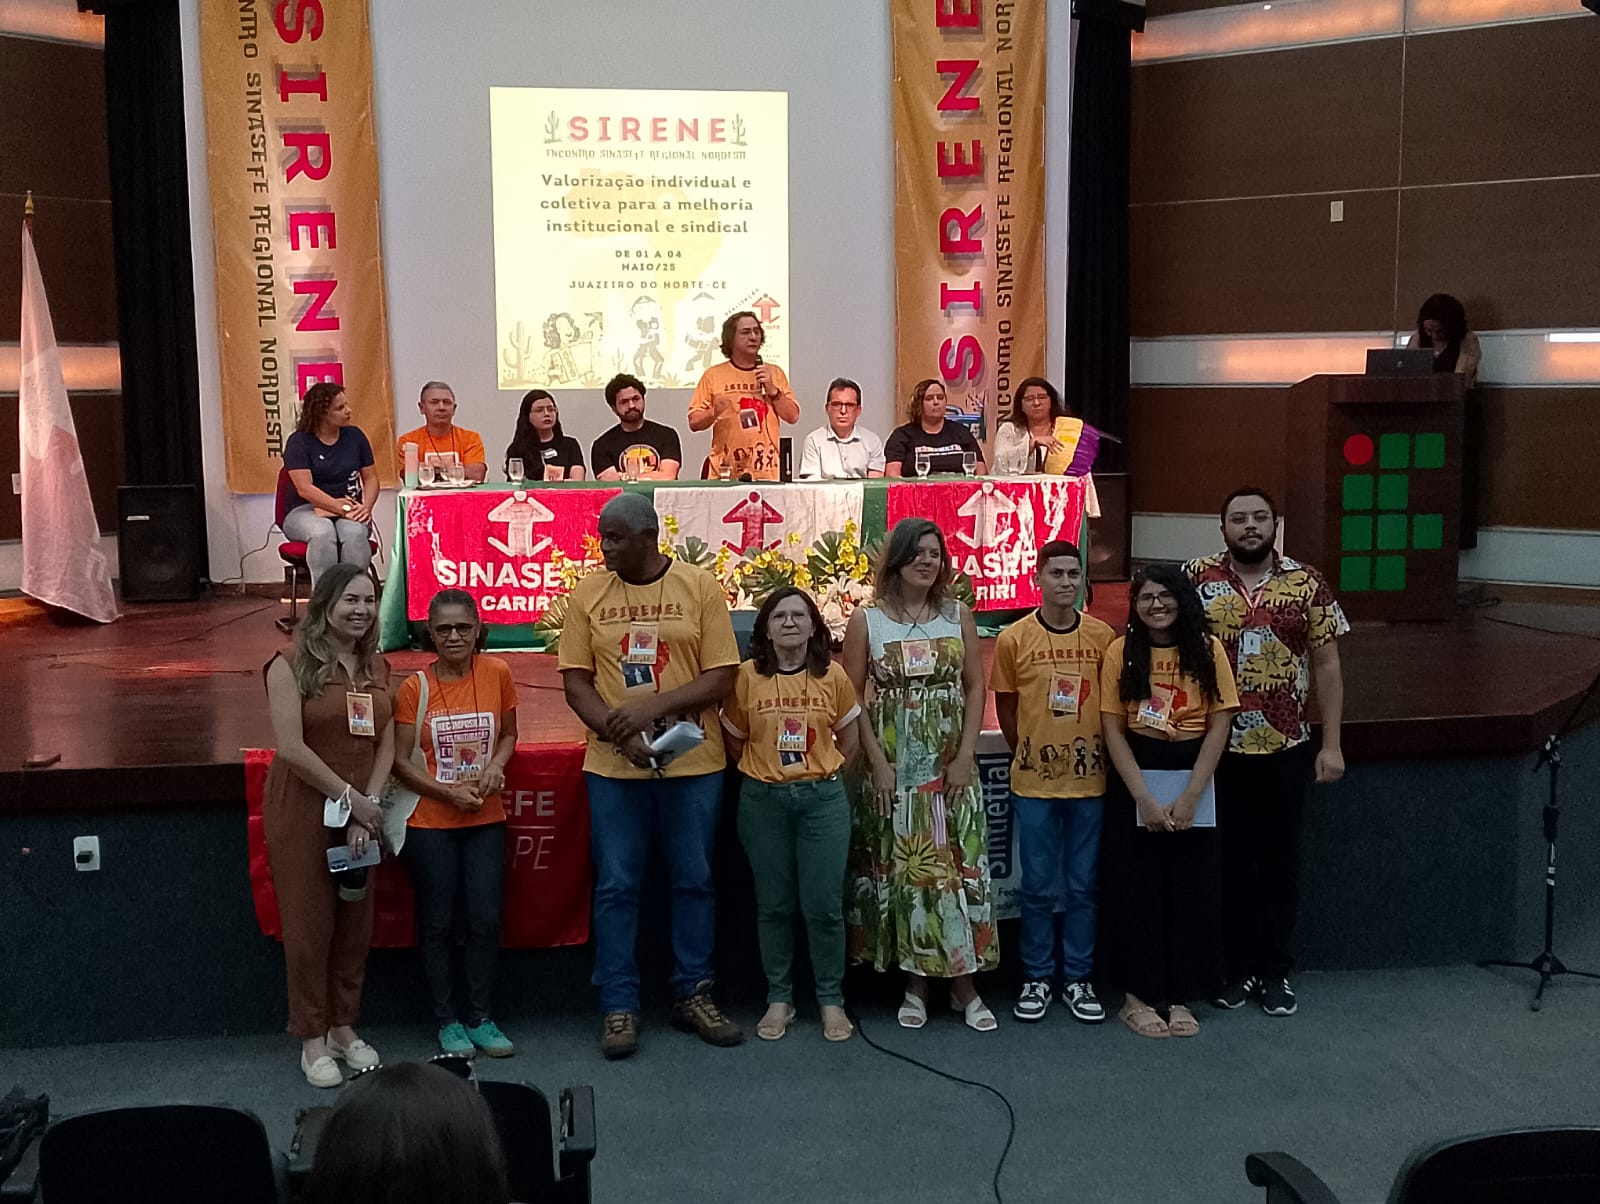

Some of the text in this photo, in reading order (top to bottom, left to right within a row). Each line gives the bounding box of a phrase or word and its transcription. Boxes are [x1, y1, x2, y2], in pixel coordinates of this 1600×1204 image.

[246, 72, 269, 194] SINASEFE
[568, 116, 727, 143] SIRENE
[996, 63, 1015, 184] REGIONAL
[542, 174, 752, 190] Valorização individual e
[936, 0, 983, 381] SIRENE
[540, 197, 753, 213] coletiva para a melhoria
[546, 219, 748, 233] institucional e sindical
[615, 250, 682, 259] DE 01 A 04
[996, 195, 1015, 308] SINASEFE
[249, 204, 276, 327] REGIONAL
[621, 263, 676, 272] MAIO/25
[569, 281, 634, 289] JUAZEIRO
[640, 281, 657, 289] DO
[996, 320, 1015, 431] NCONTRO
[258, 337, 283, 458] NORDESTE
[437, 559, 598, 589] SINASE
[481, 595, 557, 611] CARIR
[976, 584, 1016, 601] RIRI
[608, 603, 673, 618] SIRENE
[513, 835, 554, 870] PE
